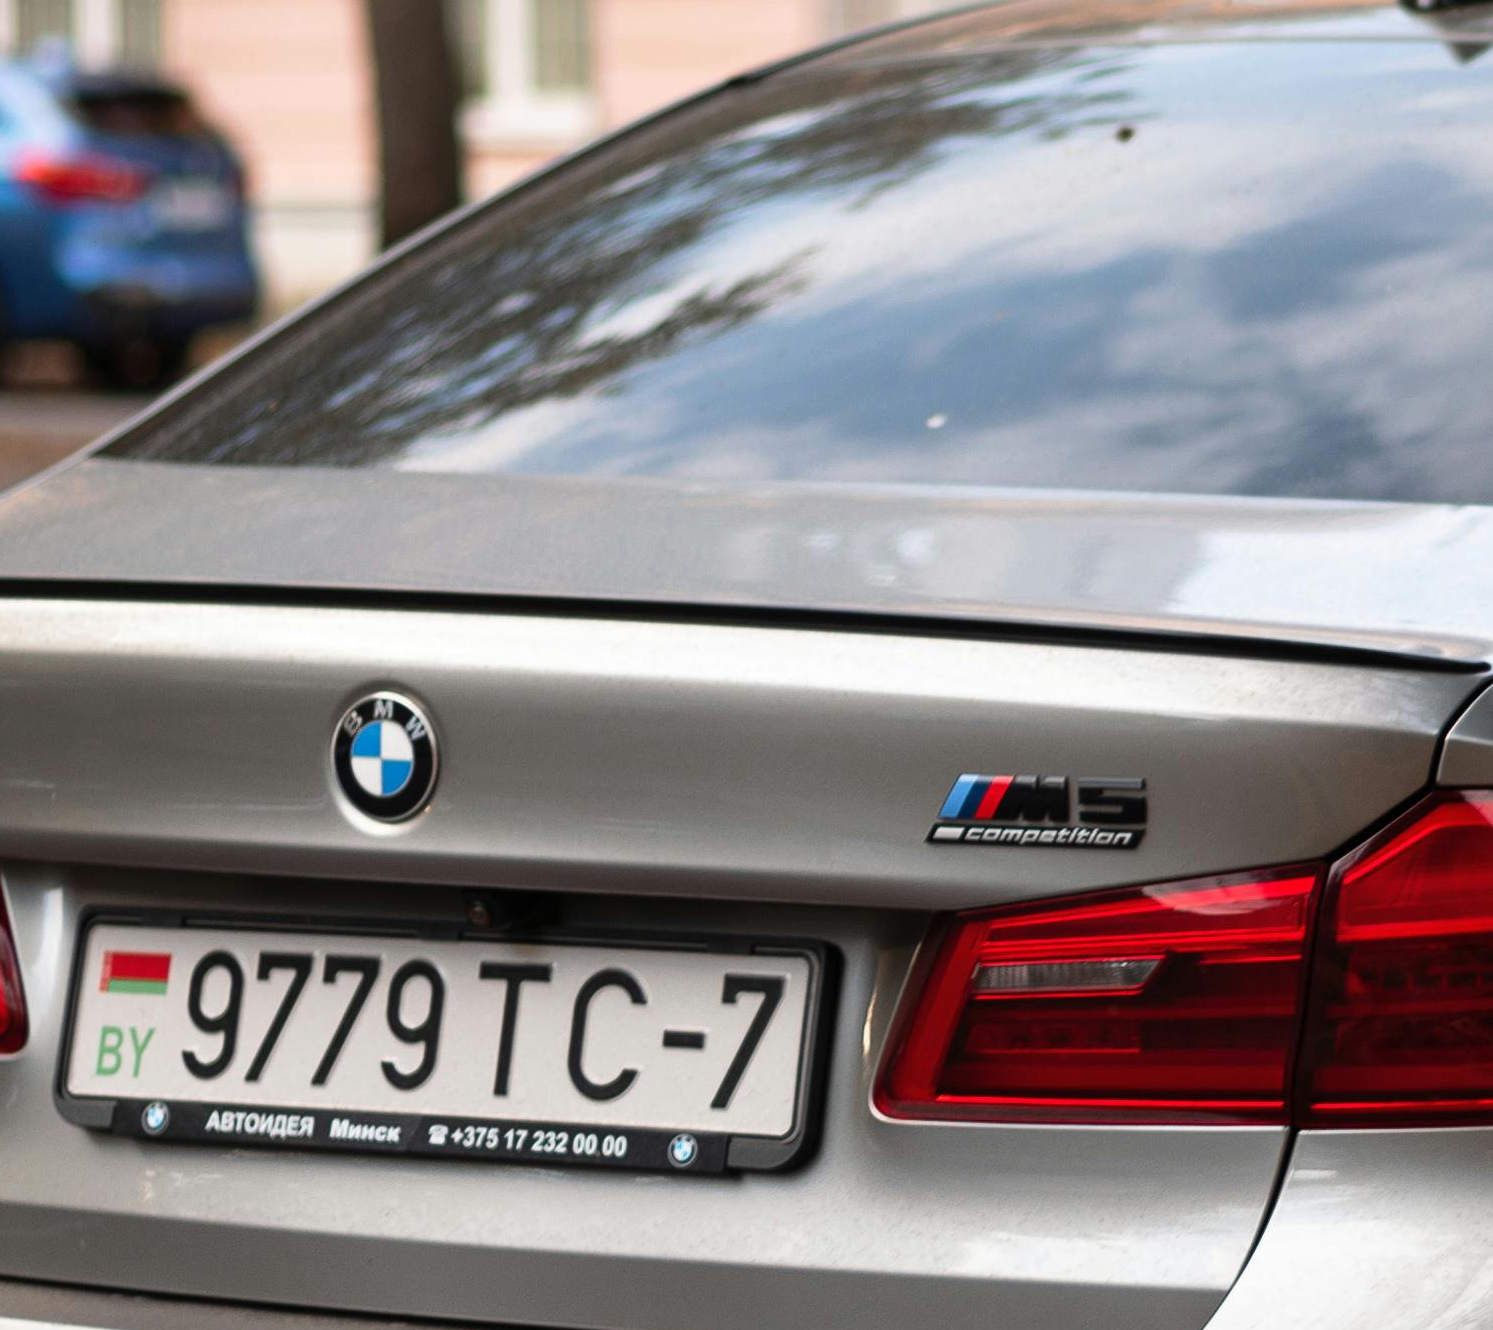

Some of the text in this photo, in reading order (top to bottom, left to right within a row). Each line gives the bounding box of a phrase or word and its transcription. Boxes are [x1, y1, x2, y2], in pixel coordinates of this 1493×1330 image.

[343, 698, 427, 742] BMW
[990, 774, 1148, 824] M5
[964, 826, 1134, 846] competition
[181, 949, 446, 1091] 9779
[94, 1025, 156, 1078] BY
[205, 1109, 628, 1157] АВТОИДЕЯ Минск +375 17 232 00 00
